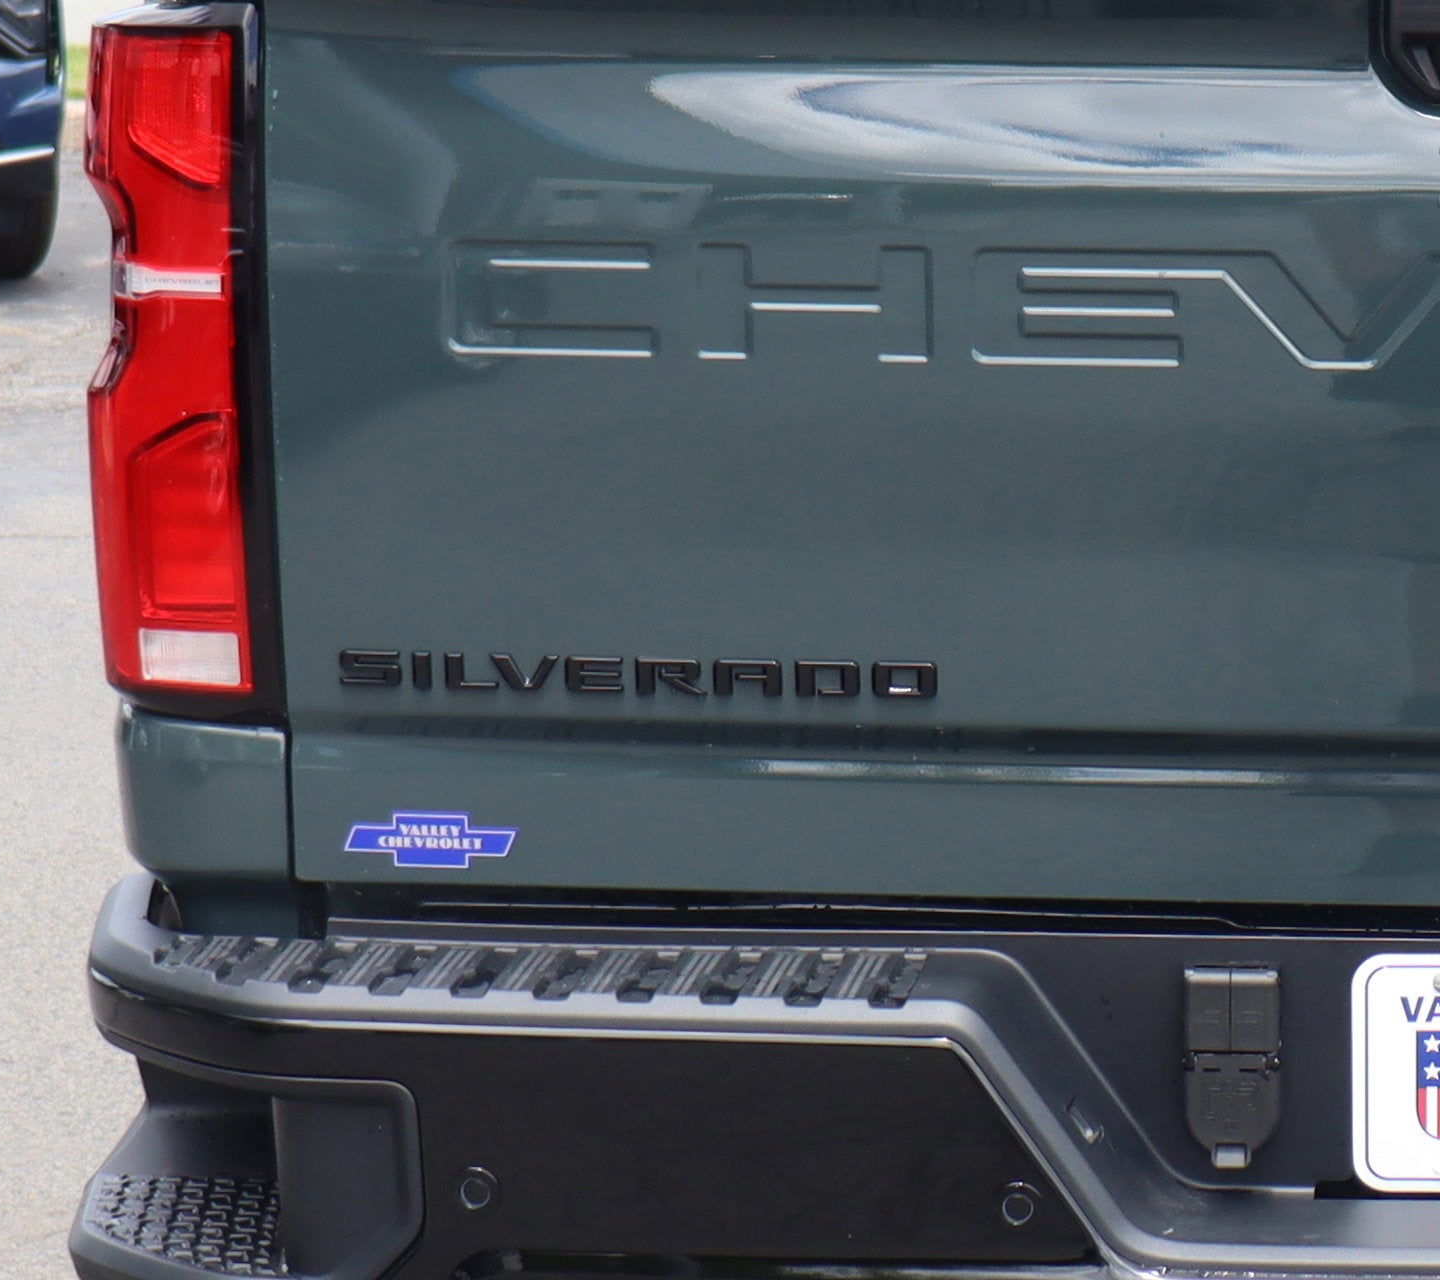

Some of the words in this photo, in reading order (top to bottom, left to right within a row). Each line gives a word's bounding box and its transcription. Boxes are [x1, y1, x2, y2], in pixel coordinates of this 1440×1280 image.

[144, 276, 220, 287] CHEVROLET
[339, 649, 938, 698] SILVERADO
[398, 823, 461, 837] VALLEY
[377, 835, 483, 850] CHEVROLET
